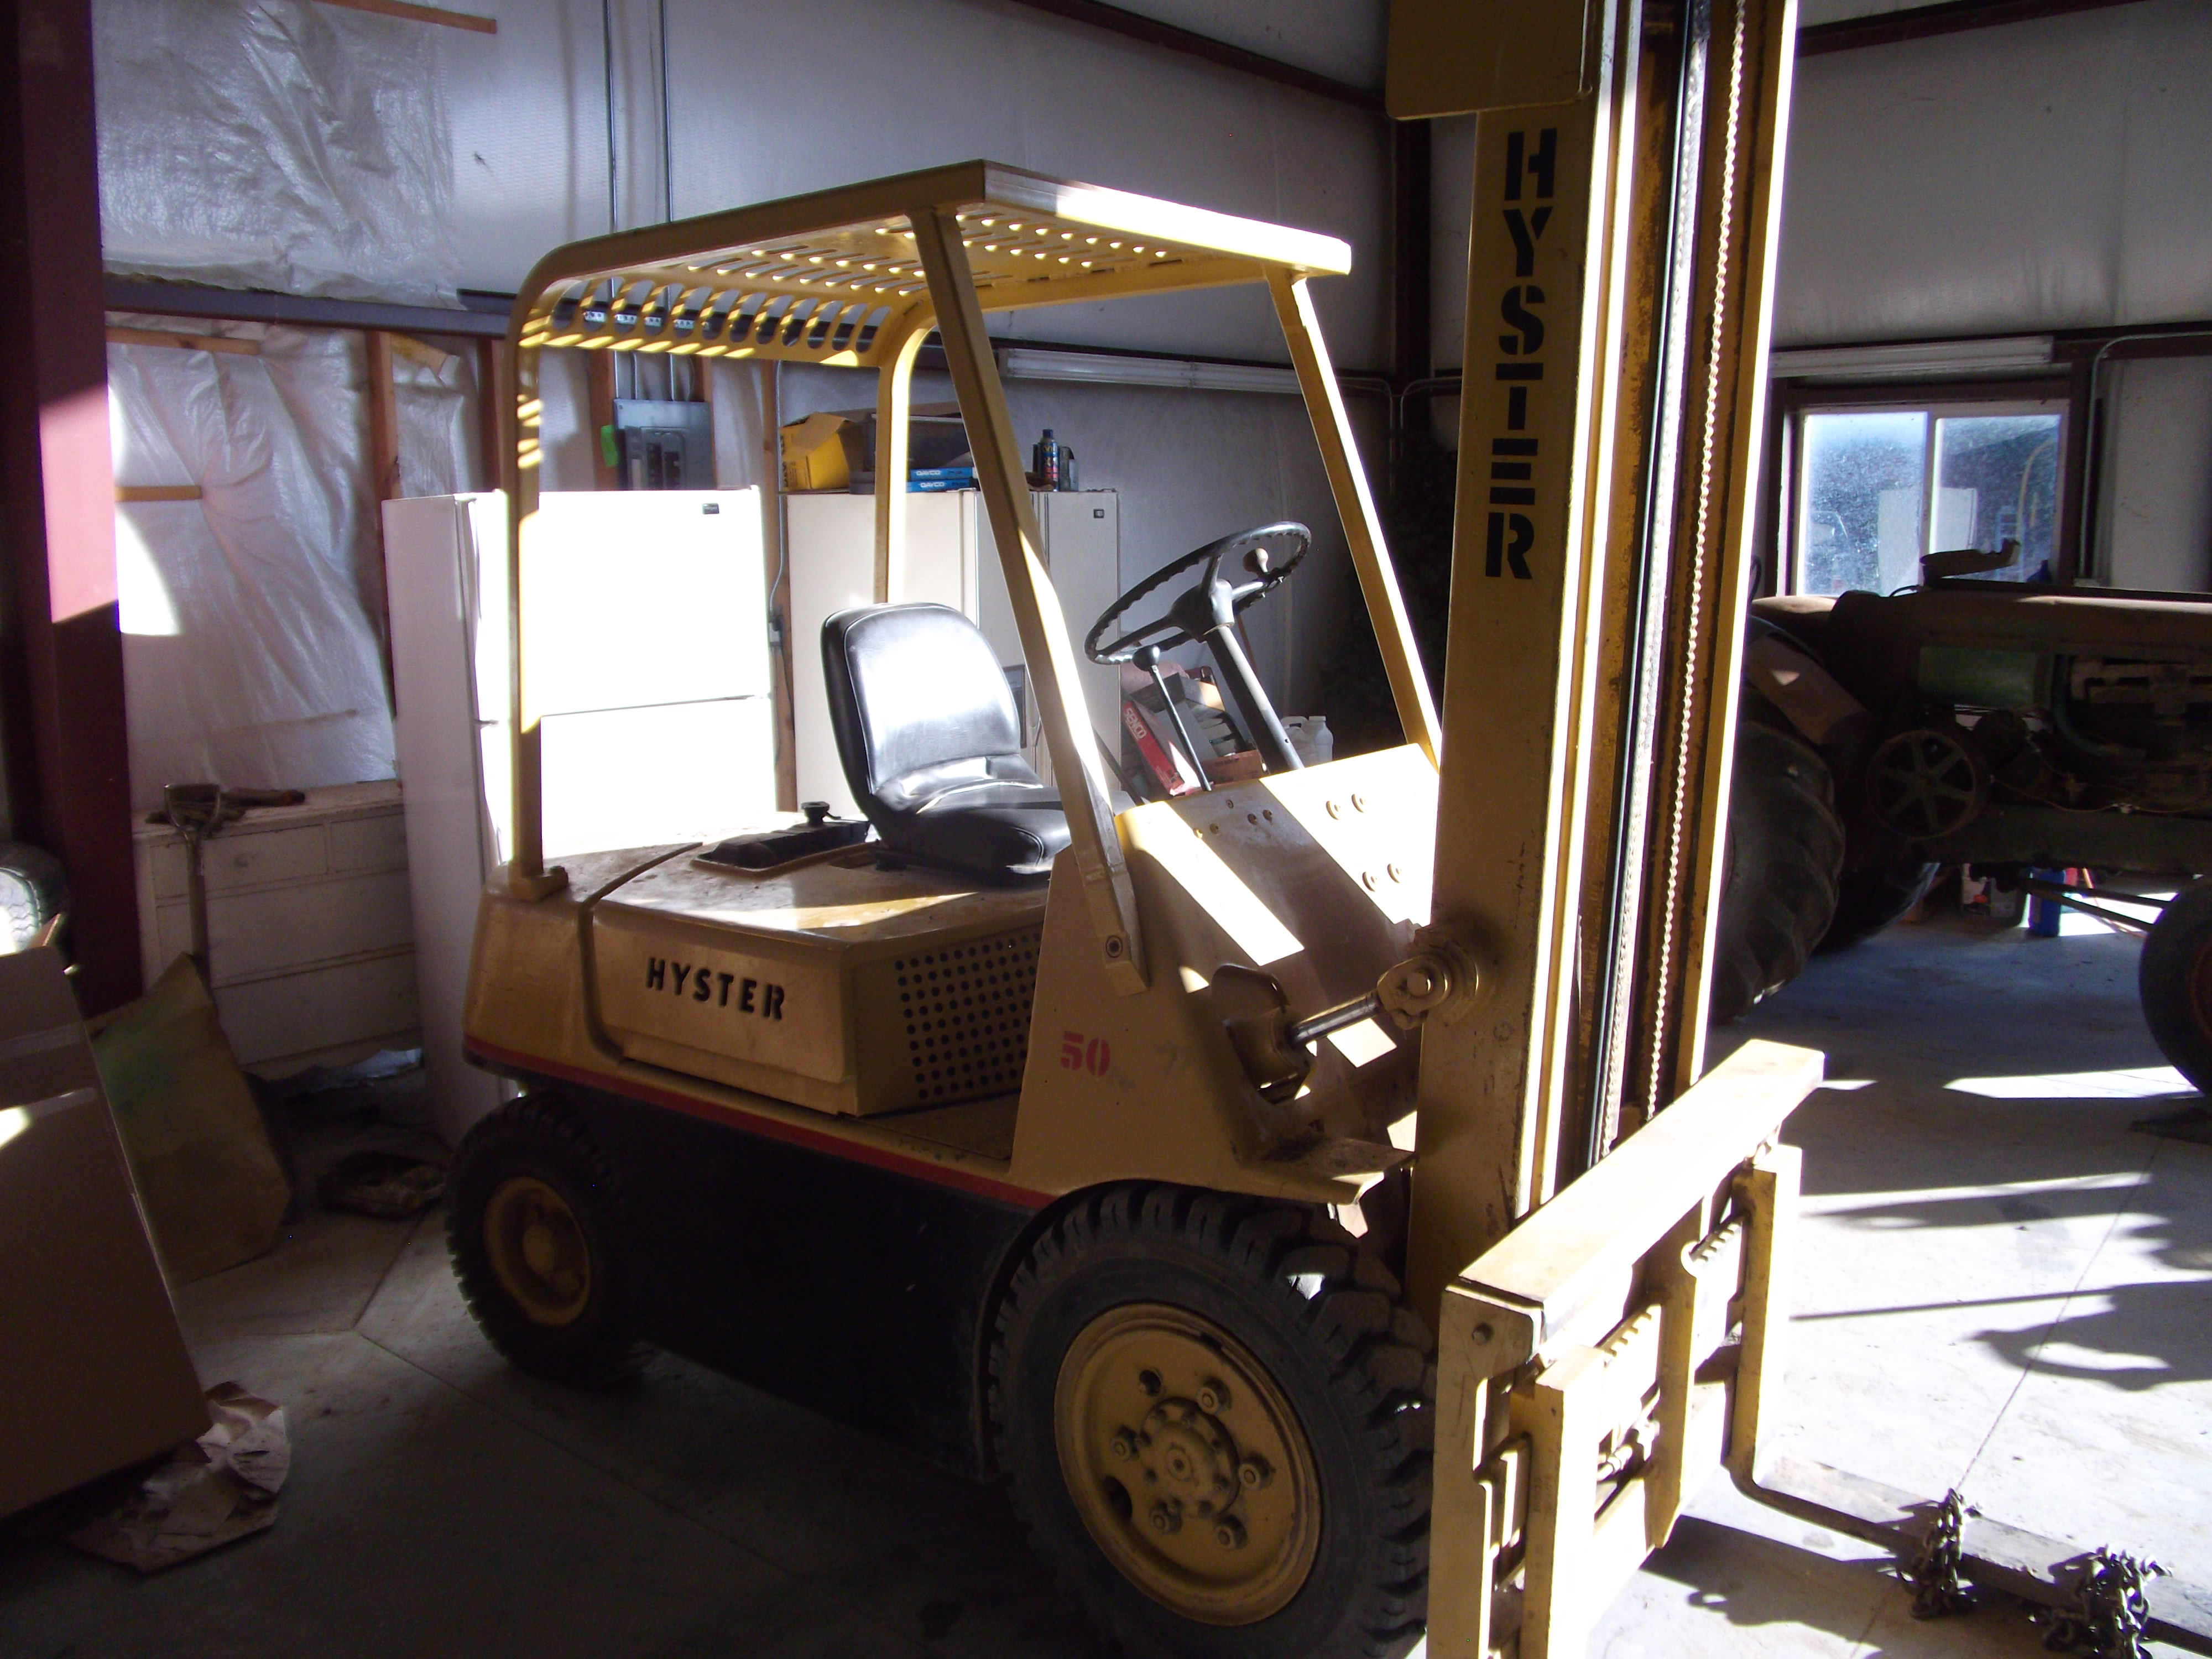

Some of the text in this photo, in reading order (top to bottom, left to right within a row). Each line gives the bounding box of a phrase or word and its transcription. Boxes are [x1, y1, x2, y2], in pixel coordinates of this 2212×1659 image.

[1485, 128, 1557, 580] HYSTER
[1124, 707, 1147, 739] SENCO
[646, 957, 785, 1020] HYSTER
[1060, 1030, 1110, 1076] 50
